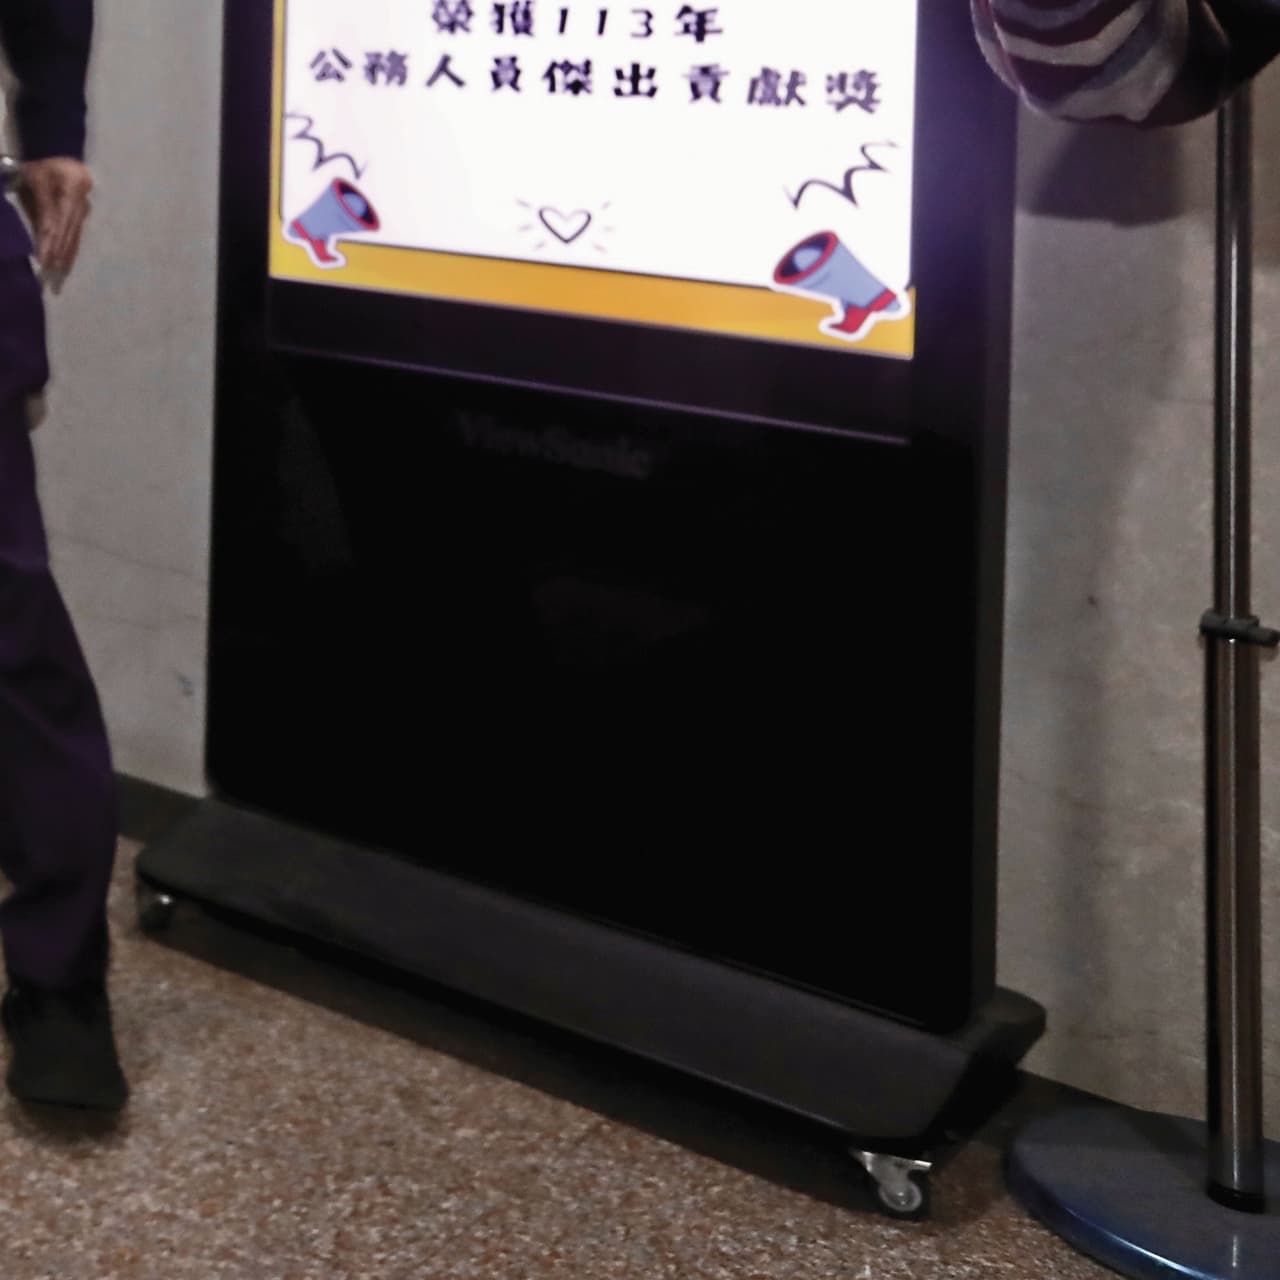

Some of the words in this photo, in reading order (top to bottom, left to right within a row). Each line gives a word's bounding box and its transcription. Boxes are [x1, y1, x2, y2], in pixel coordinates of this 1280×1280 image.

[308, 47, 882, 114] 公務人員傑出貢獻獎
